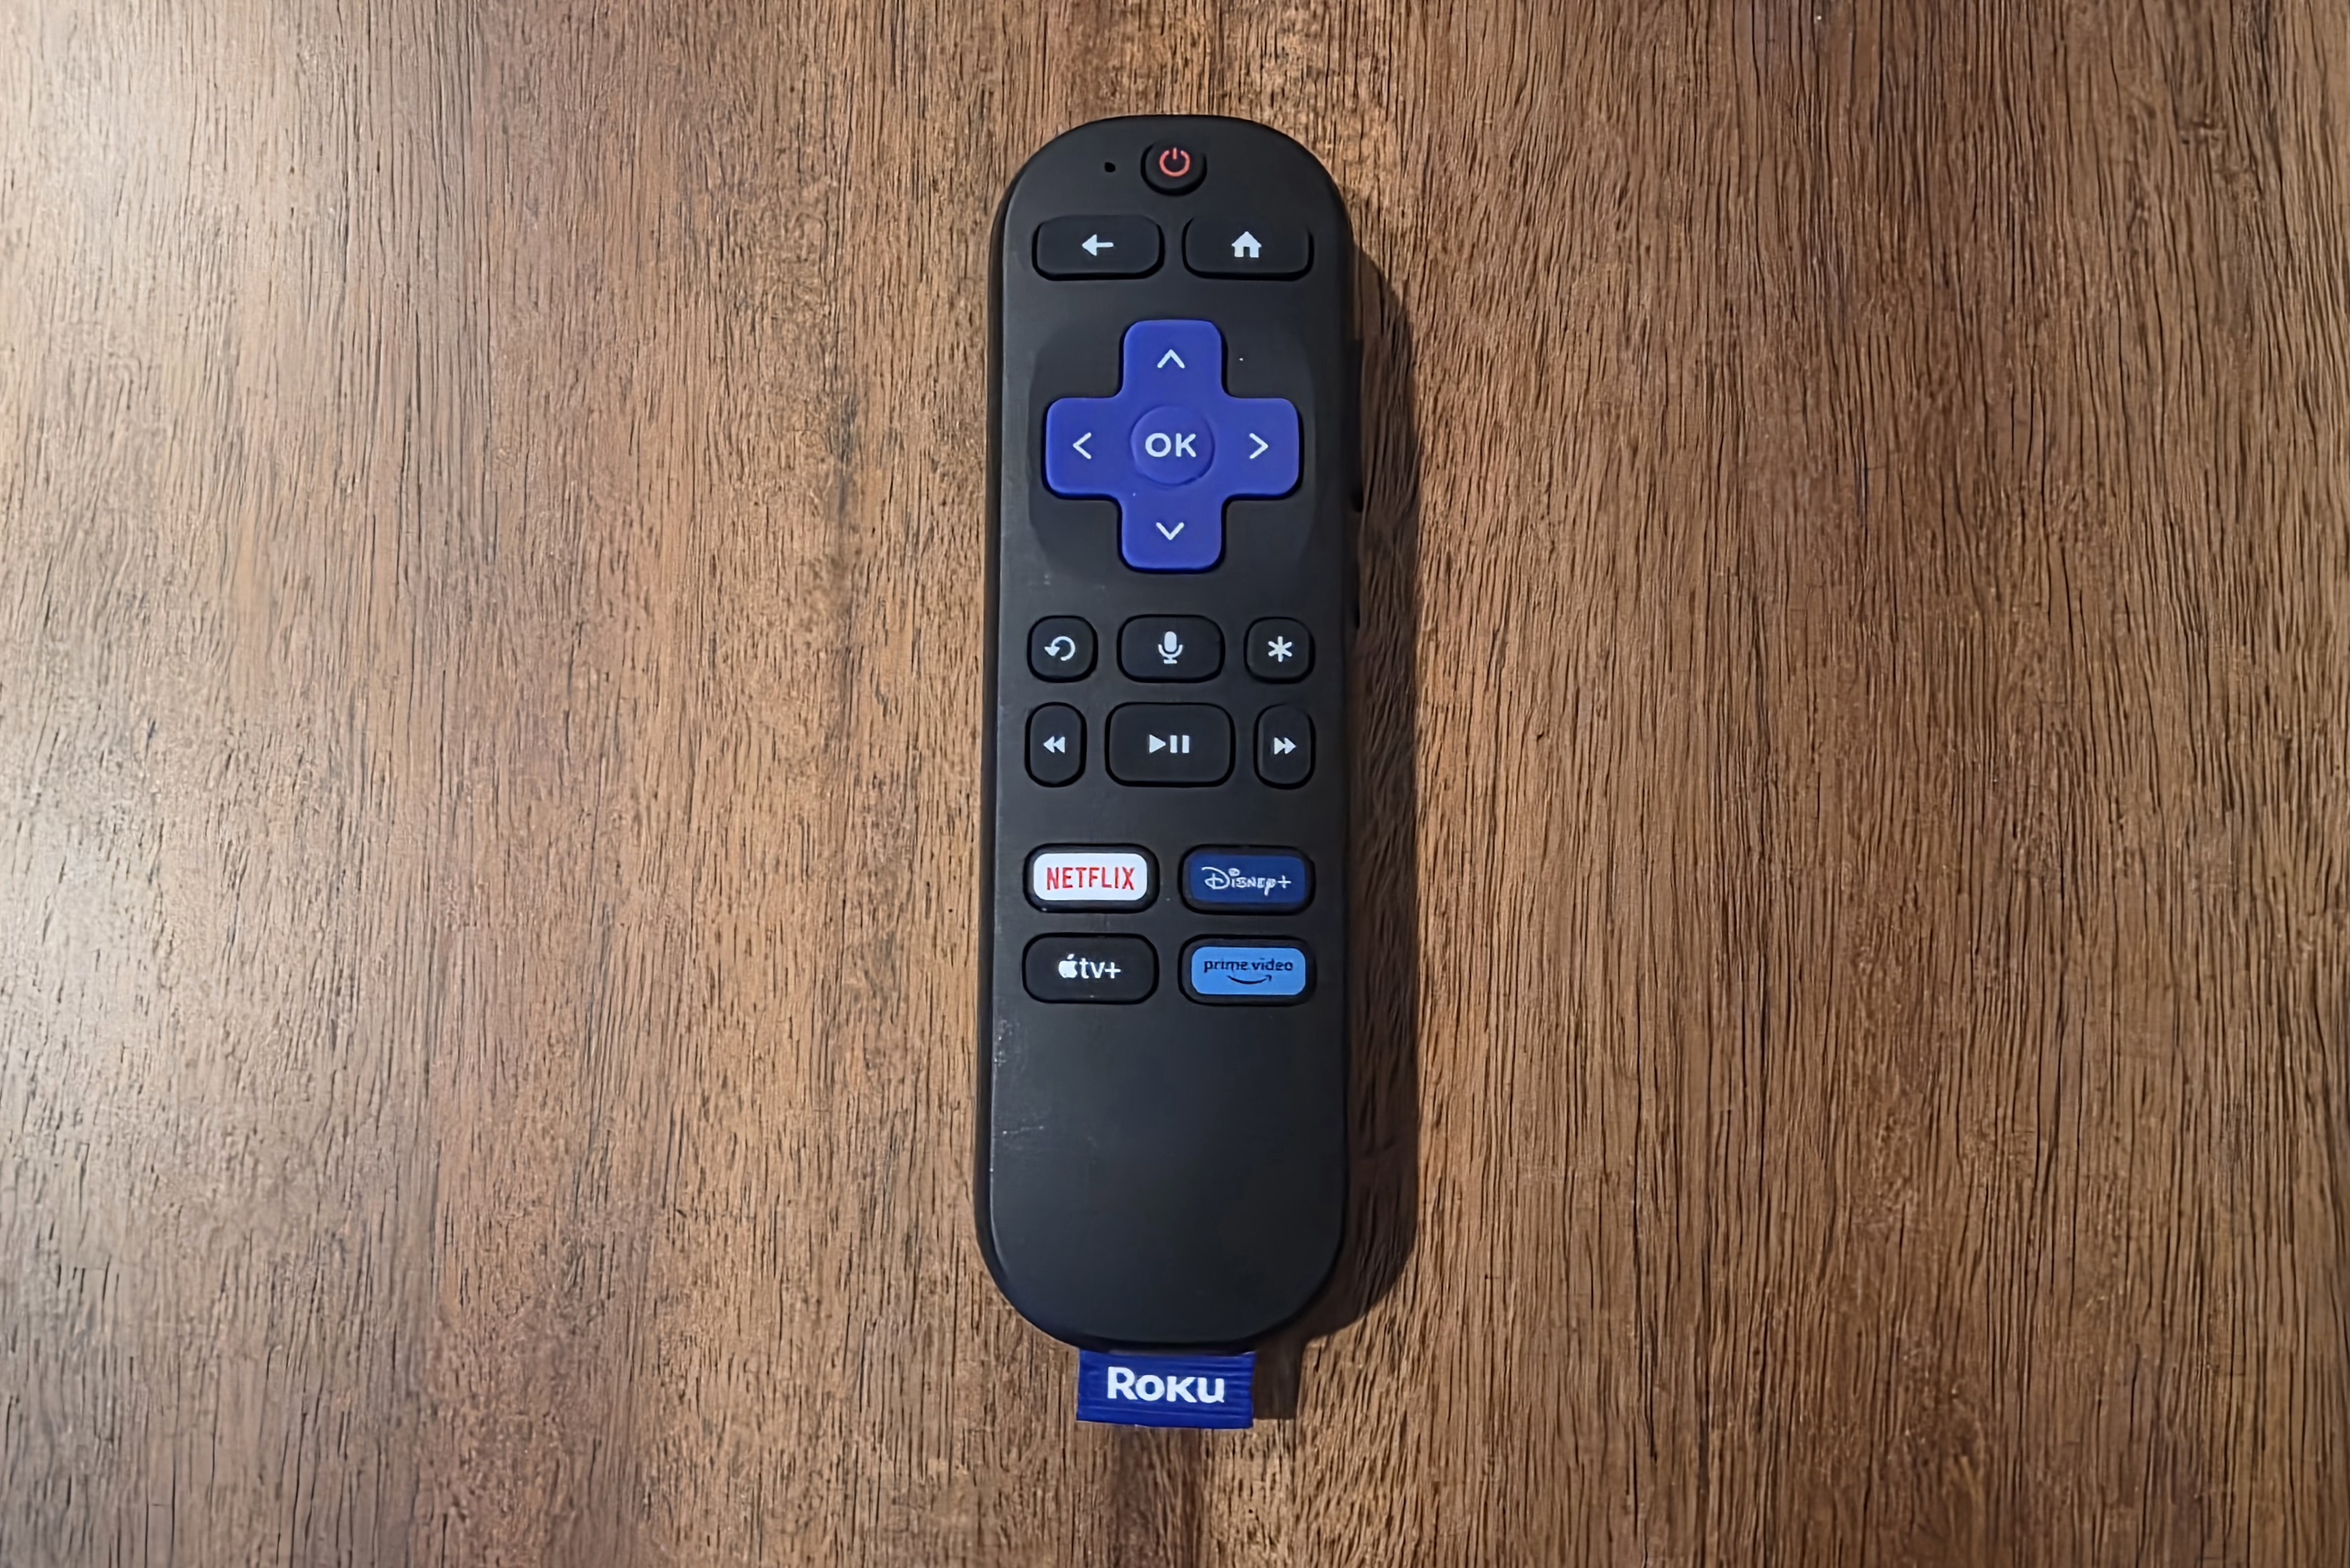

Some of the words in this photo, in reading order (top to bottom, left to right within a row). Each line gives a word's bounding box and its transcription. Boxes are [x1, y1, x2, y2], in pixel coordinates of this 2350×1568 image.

[1145, 432, 1197, 458] OK
[1046, 866, 1135, 891] NETFLIX
[1203, 958, 1248, 973] prime
[1251, 958, 1293, 972] video
